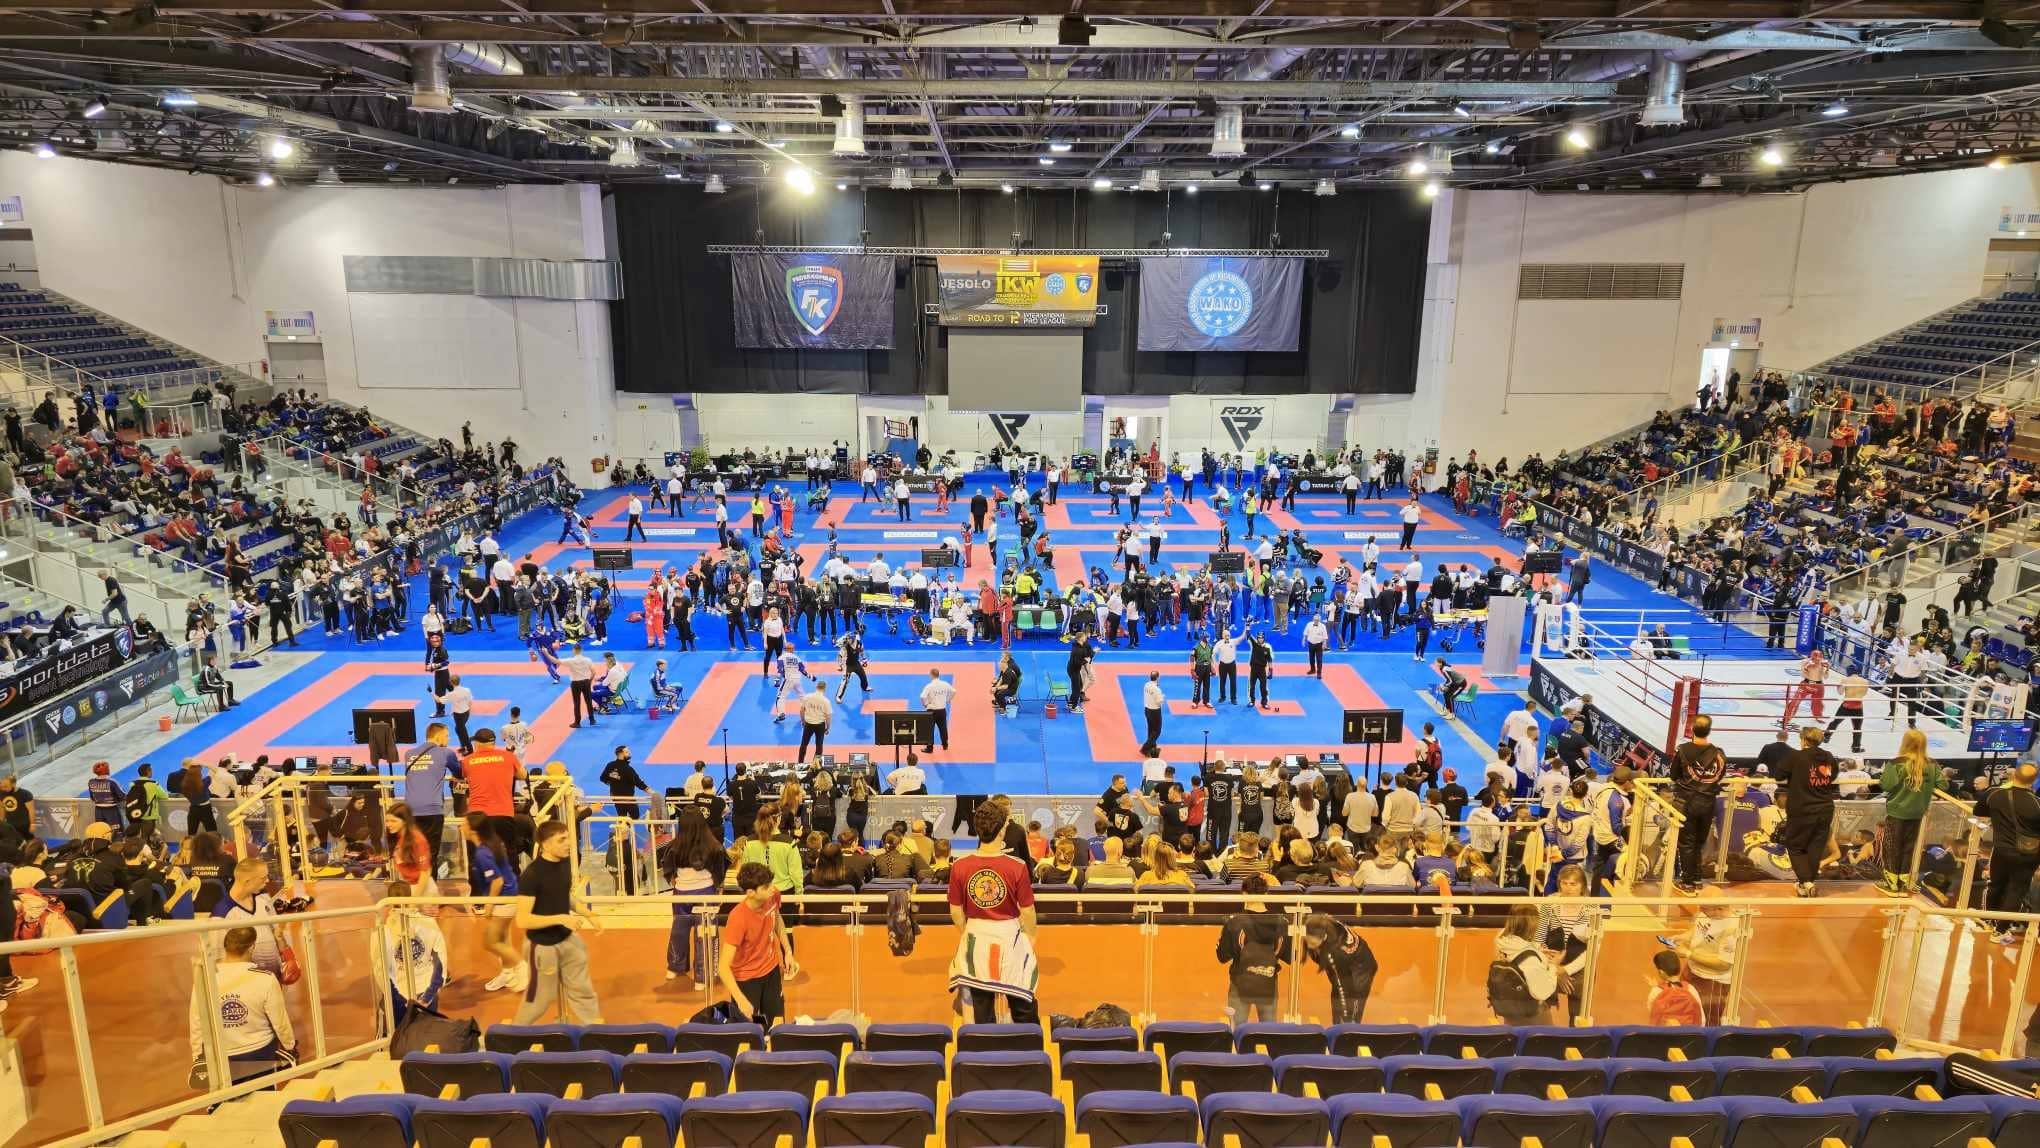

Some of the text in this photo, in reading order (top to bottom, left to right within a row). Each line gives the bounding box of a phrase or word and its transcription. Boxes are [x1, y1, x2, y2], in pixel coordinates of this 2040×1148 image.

[940, 279, 991, 289] JESOLO
[1200, 297, 1241, 312] WAKO
[968, 314, 991, 322] ROAD
[993, 314, 1004, 322] TO
[1220, 406, 1265, 415] RDX
[19, 642, 113, 696] portdata
[469, 755, 505, 765] CZECHIA
